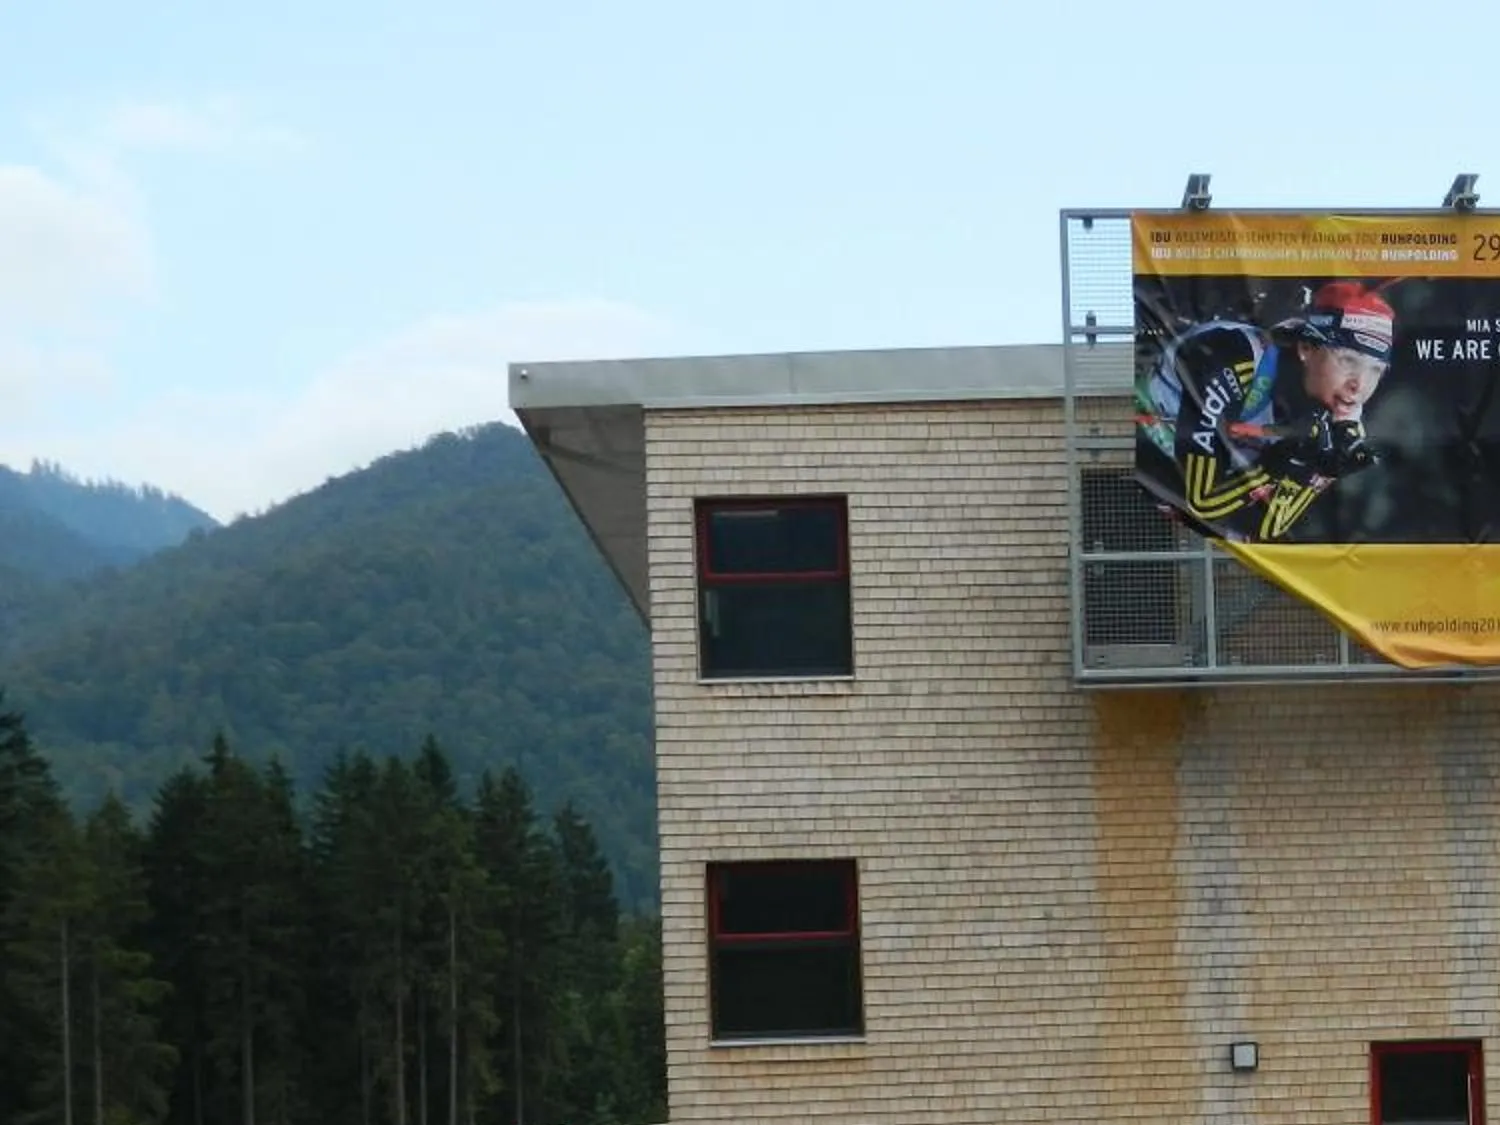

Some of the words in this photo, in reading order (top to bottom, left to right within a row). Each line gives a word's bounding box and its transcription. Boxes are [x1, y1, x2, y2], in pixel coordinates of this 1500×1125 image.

[1381, 232, 1457, 245] RUHPOLDING
[1381, 249, 1459, 261] RUHPOLDING
[1467, 319, 1490, 333] MIA
[1415, 339, 1445, 360] WE
[1451, 339, 1492, 360] ARE
[1192, 378, 1231, 454] Audi
